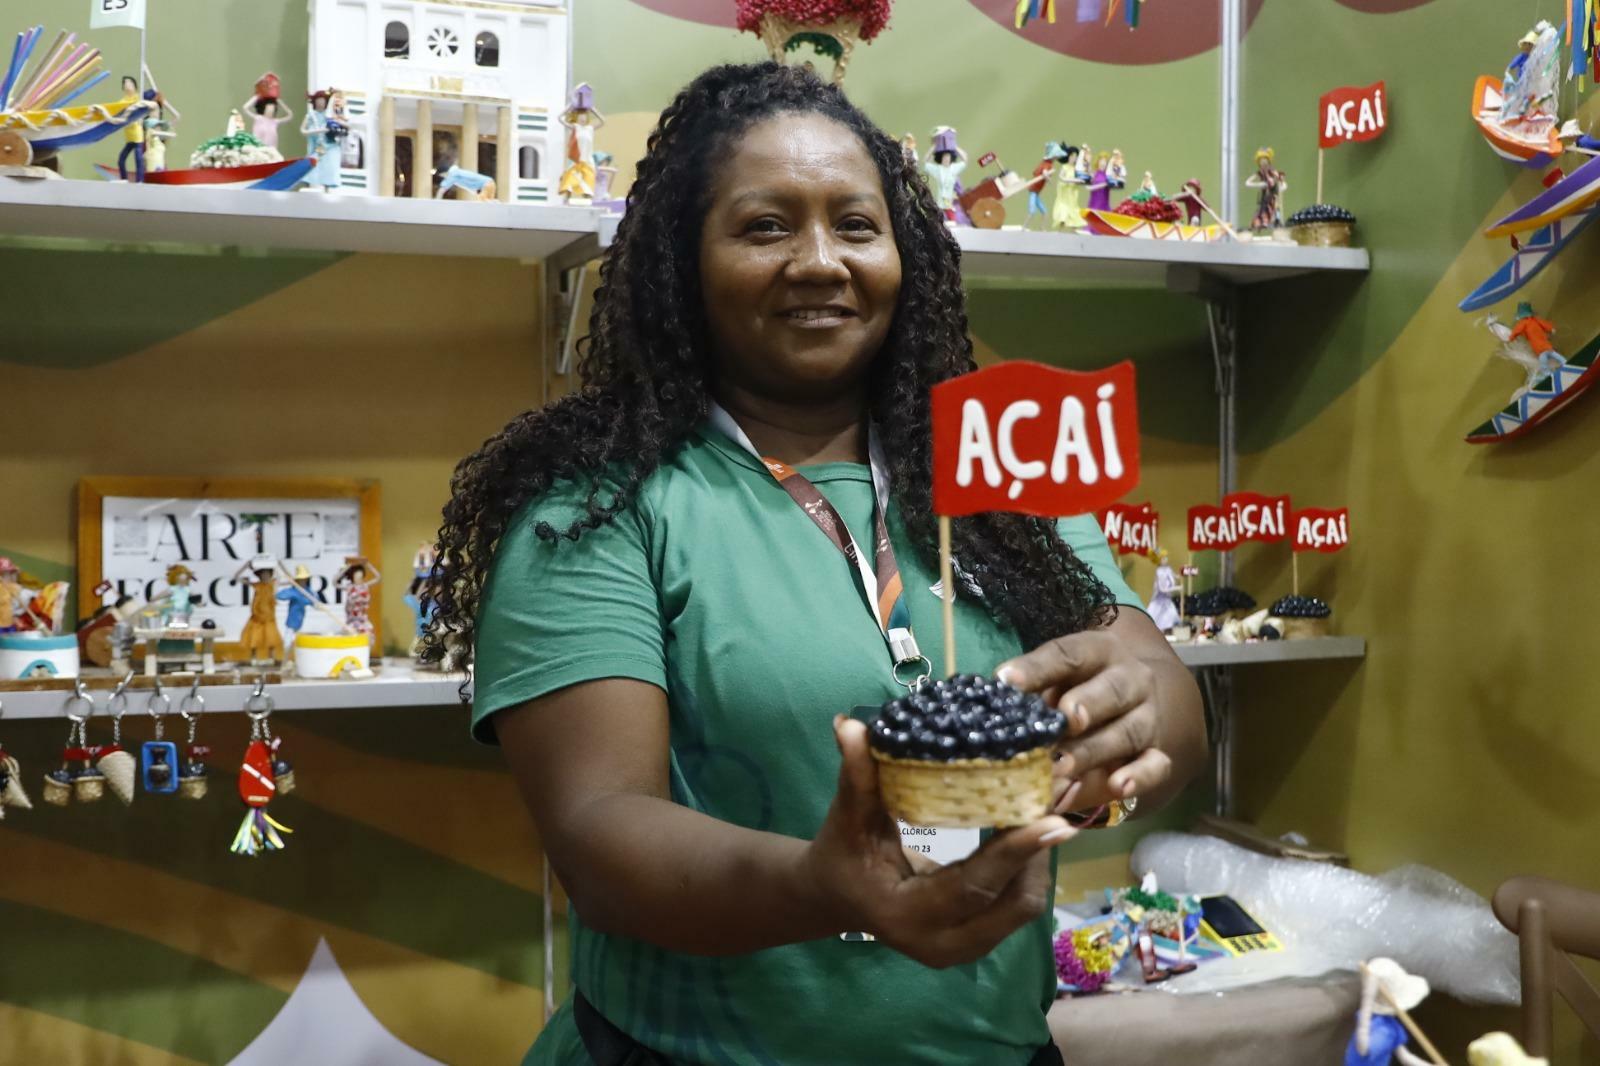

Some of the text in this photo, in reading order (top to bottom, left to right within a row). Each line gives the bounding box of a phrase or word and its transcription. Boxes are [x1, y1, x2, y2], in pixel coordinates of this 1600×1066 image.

[1325, 89, 1385, 140] AÇAÍ
[955, 382, 1124, 501] AÇAÍ
[150, 512, 321, 562] ARTE
[1193, 512, 1237, 545] AÇAÍ
[1297, 513, 1348, 548] AÇAÍ
[922, 845, 931, 853] 23
